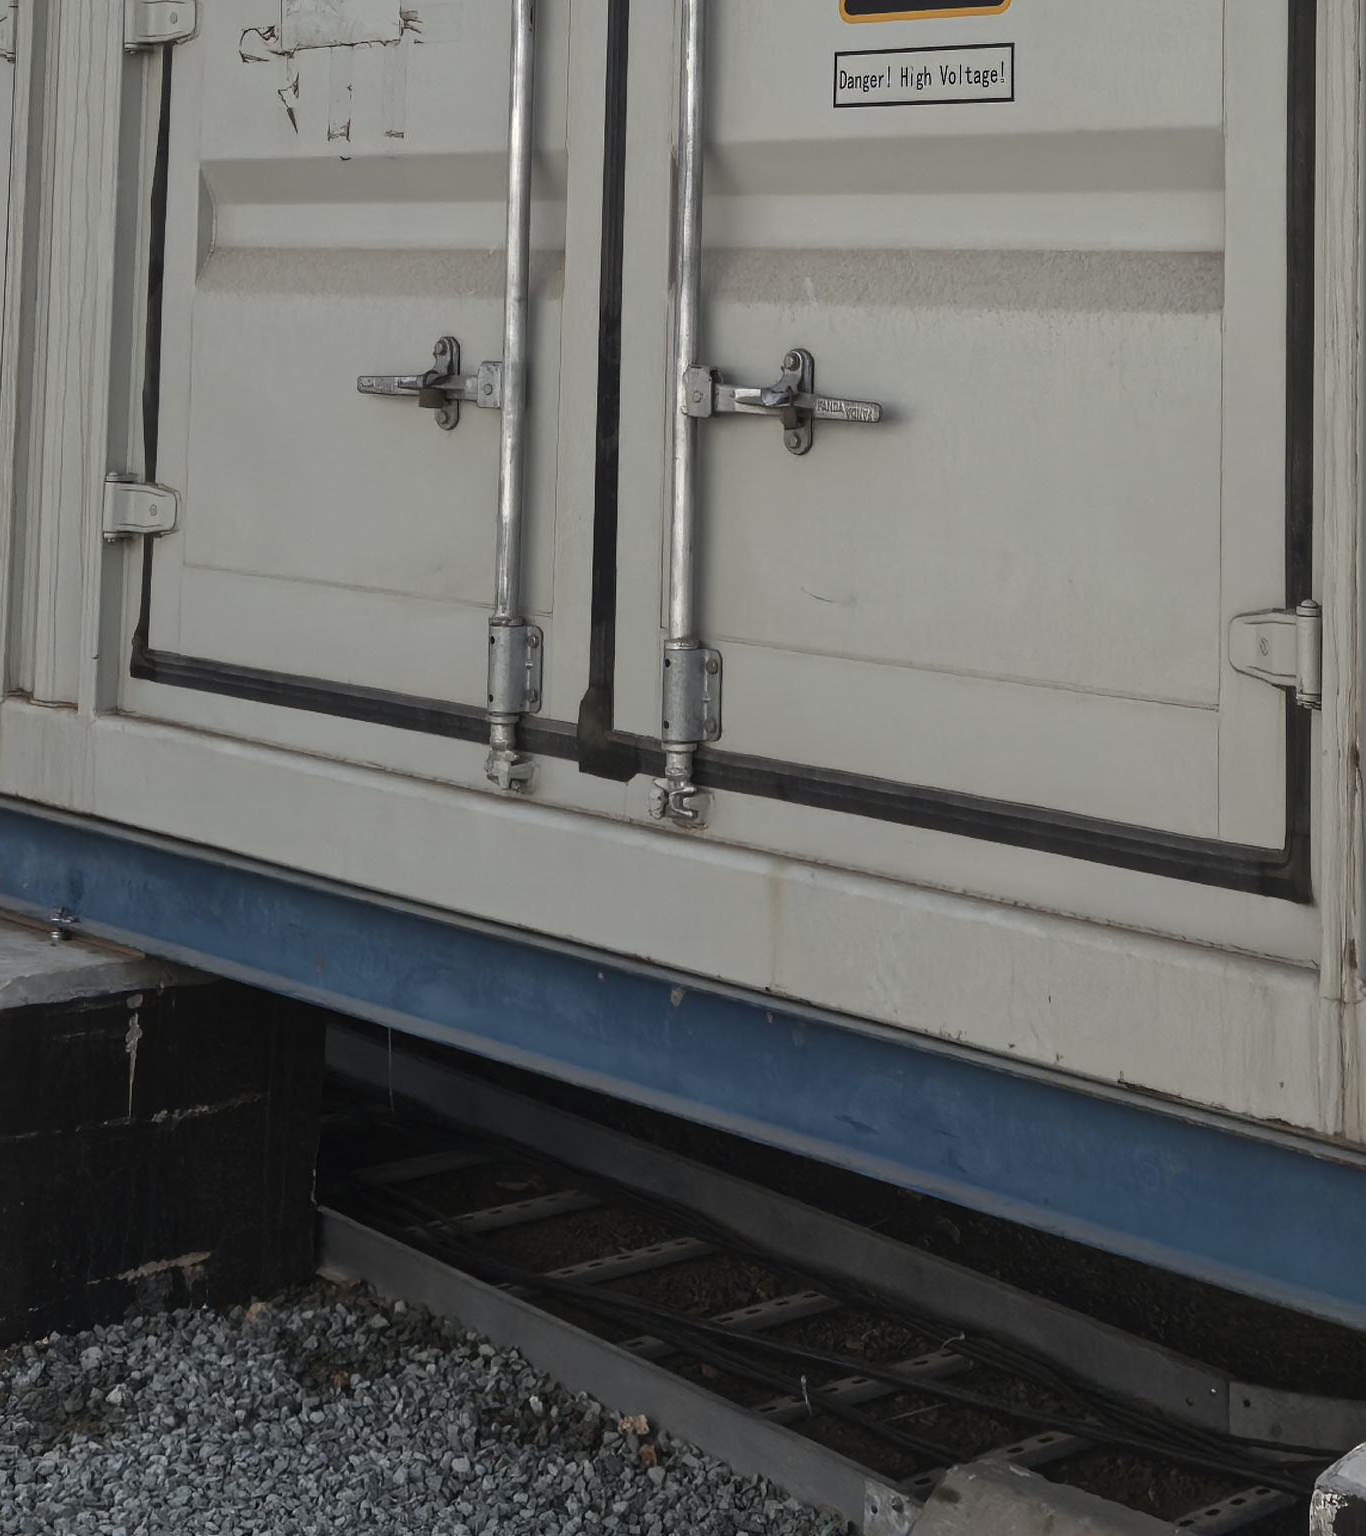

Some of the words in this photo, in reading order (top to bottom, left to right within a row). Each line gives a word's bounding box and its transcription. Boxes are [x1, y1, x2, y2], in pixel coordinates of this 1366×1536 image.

[838, 65, 891, 92] Danger!
[900, 65, 932, 90] High
[939, 61, 1004, 87] Voltage!
